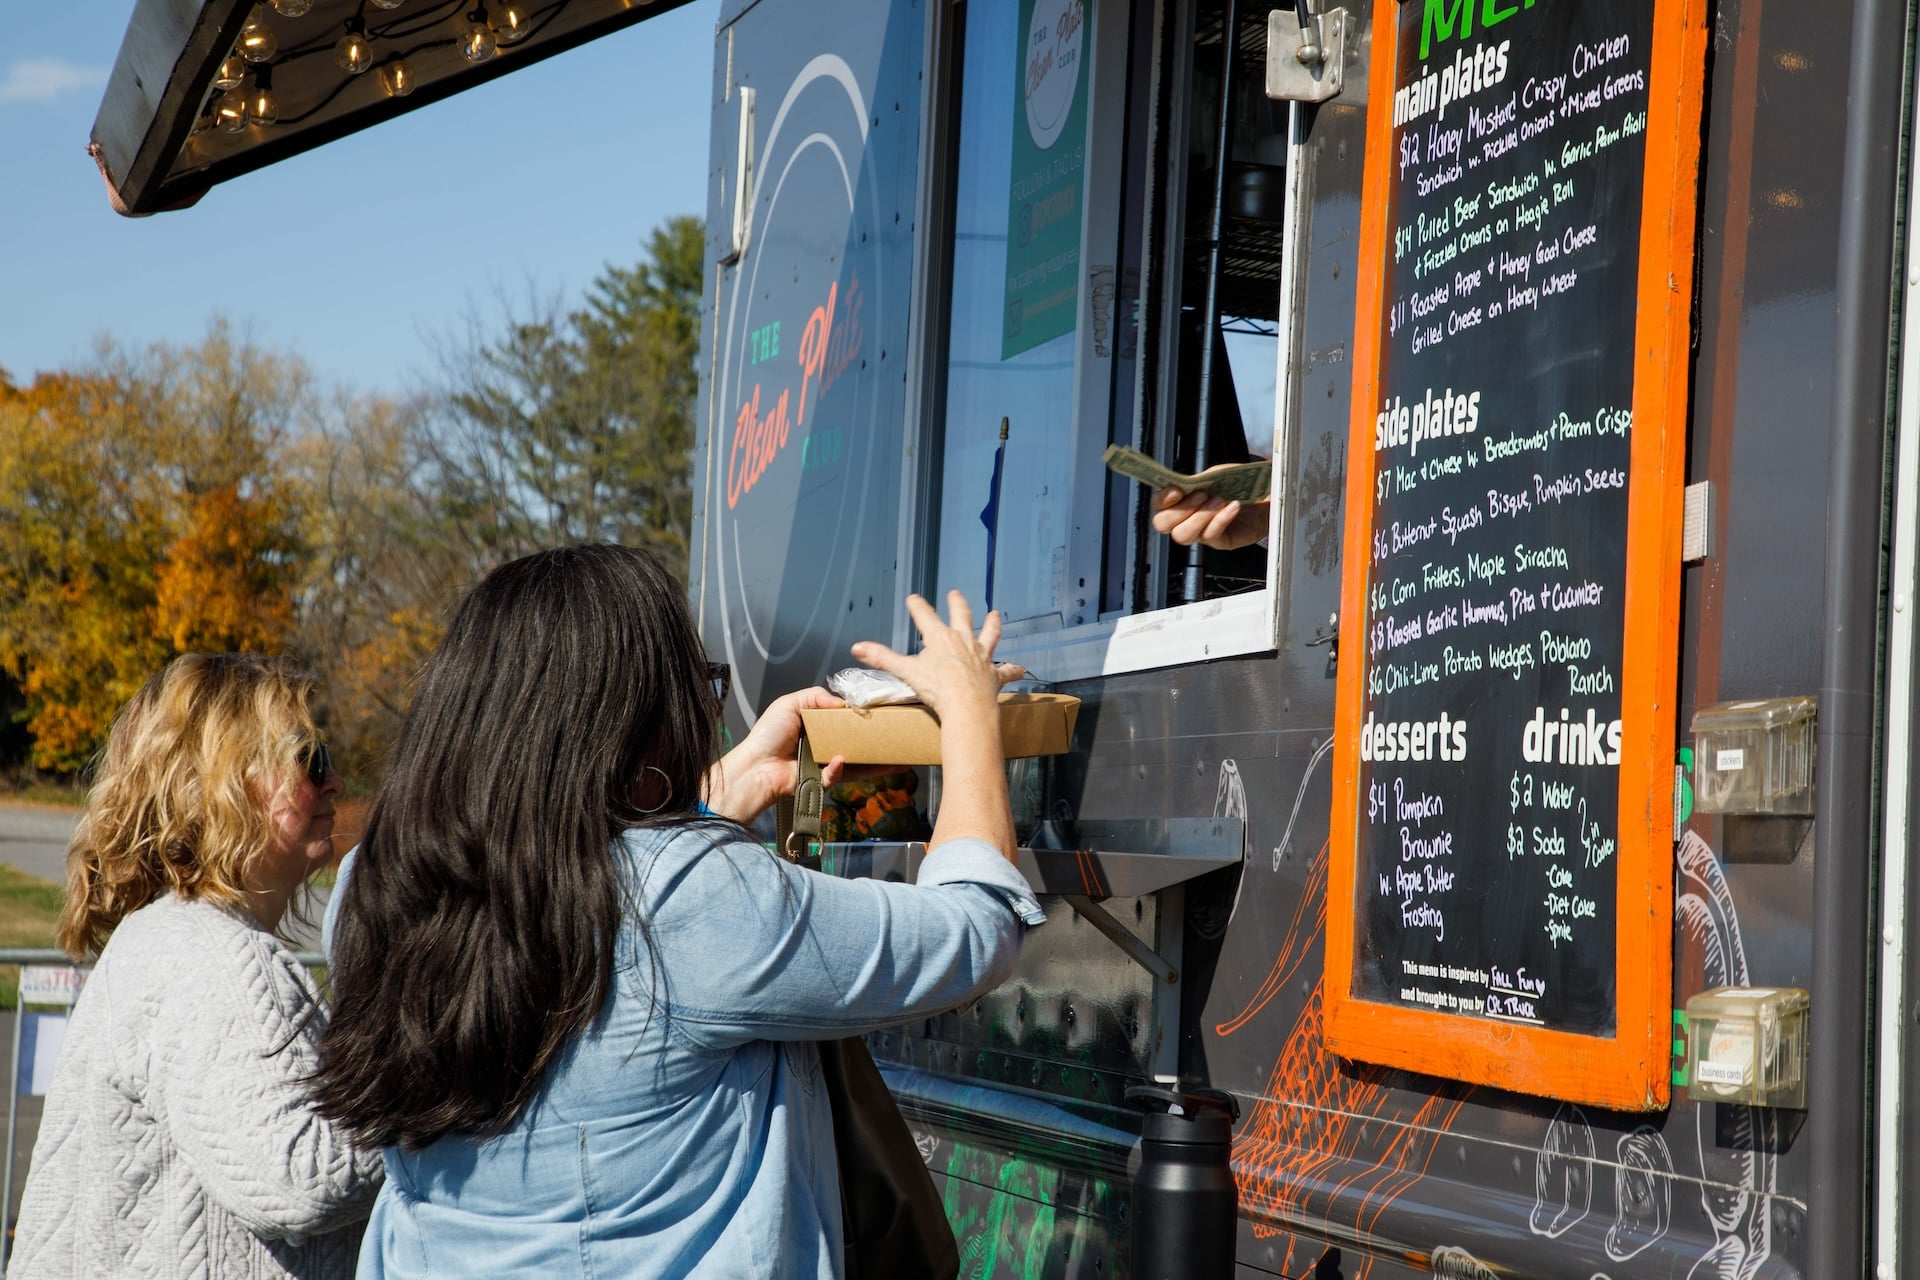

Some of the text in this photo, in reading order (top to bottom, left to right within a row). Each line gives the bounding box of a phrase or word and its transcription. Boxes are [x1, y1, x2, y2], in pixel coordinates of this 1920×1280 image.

[1058, 48, 1075, 69] CLUB
[1393, 40, 1510, 127] main plates
[1400, 34, 1629, 180] $12 Honey Mustard Crispy Chicken
[1417, 159, 1462, 197] Sandwich
[1521, 111, 1554, 142] Onions
[1568, 85, 1601, 118] Mixed
[1604, 70, 1644, 103] Greens
[1395, 223, 1413, 263] $14
[1417, 211, 1450, 244] Pulled
[1454, 192, 1481, 228] Beef
[1488, 173, 1538, 208] Sandwich
[1561, 140, 1592, 168] Garlic
[1595, 126, 1619, 150] Parm
[1622, 112, 1646, 138] Aioli
[1423, 245, 1457, 277] Frizzled
[1460, 226, 1492, 253] Onions
[1496, 219, 1509, 236] on
[1515, 203, 1549, 233] Hoagie
[1553, 179, 1575, 207] Roll
[1390, 301, 1405, 337] $11
[1411, 285, 1450, 322] Roasted
[1454, 268, 1481, 299] Apple
[1500, 251, 1531, 282] Honey
[1535, 240, 1559, 266] Goat
[1563, 223, 1597, 253] Cheese
[751, 320, 781, 366] THE
[1412, 323, 1443, 355] Grilled
[1448, 303, 1482, 336] Cheese
[1488, 300, 1502, 318] on
[1507, 285, 1539, 316] Honey
[727, 267, 864, 510] Clean Plate
[1375, 388, 1480, 457] side plates
[802, 426, 843, 472] CLUB
[1377, 469, 1391, 505] $7
[1396, 465, 1417, 494] Mac
[1429, 453, 1462, 481] Cheese
[1484, 430, 1549, 463] Breadcrumbs
[1558, 412, 1592, 441] Parm
[1373, 468, 1626, 567] $6 Butternut Squash Bisque, Pumpkin Seeds
[1371, 544, 1569, 619] $6 Corn Fritters, Maple Sriracha
[1370, 621, 1385, 660] $8
[1387, 614, 1422, 650] Roasted
[1426, 607, 1458, 636] Garlic
[1463, 598, 1508, 627] Hummus,
[1510, 587, 1536, 621] Pita
[1551, 579, 1604, 612] Cucumber
[1368, 630, 1591, 701] $6 Chili-Lime Potato Wedges, Poblano
[1567, 664, 1613, 697] Ranch
[1360, 711, 1467, 762] desserts
[1522, 706, 1622, 766] drinks
[1368, 777, 1443, 828] $4 Pumpkin
[1542, 781, 1574, 810] Water
[1400, 826, 1453, 862] Brownie
[1507, 822, 1565, 860] $2 Soda
[1590, 822, 1600, 840] in
[1396, 865, 1424, 900] Apple
[1424, 867, 1455, 894] Butter
[1571, 895, 1596, 918] Coke
[1401, 899, 1444, 942] Frosting
[1402, 960, 1418, 974] This
[1419, 964, 1439, 978] menu
[1440, 964, 1447, 978] is
[1448, 965, 1479, 984] inspired
[1480, 969, 1489, 988] by
[1401, 987, 1416, 1000] and
[1416, 988, 1448, 1009] brought
[1448, 993, 1457, 1004] to
[1458, 998, 1474, 1012] you
[1475, 996, 1484, 1014] by
[1702, 1065, 1742, 1081] business cards
